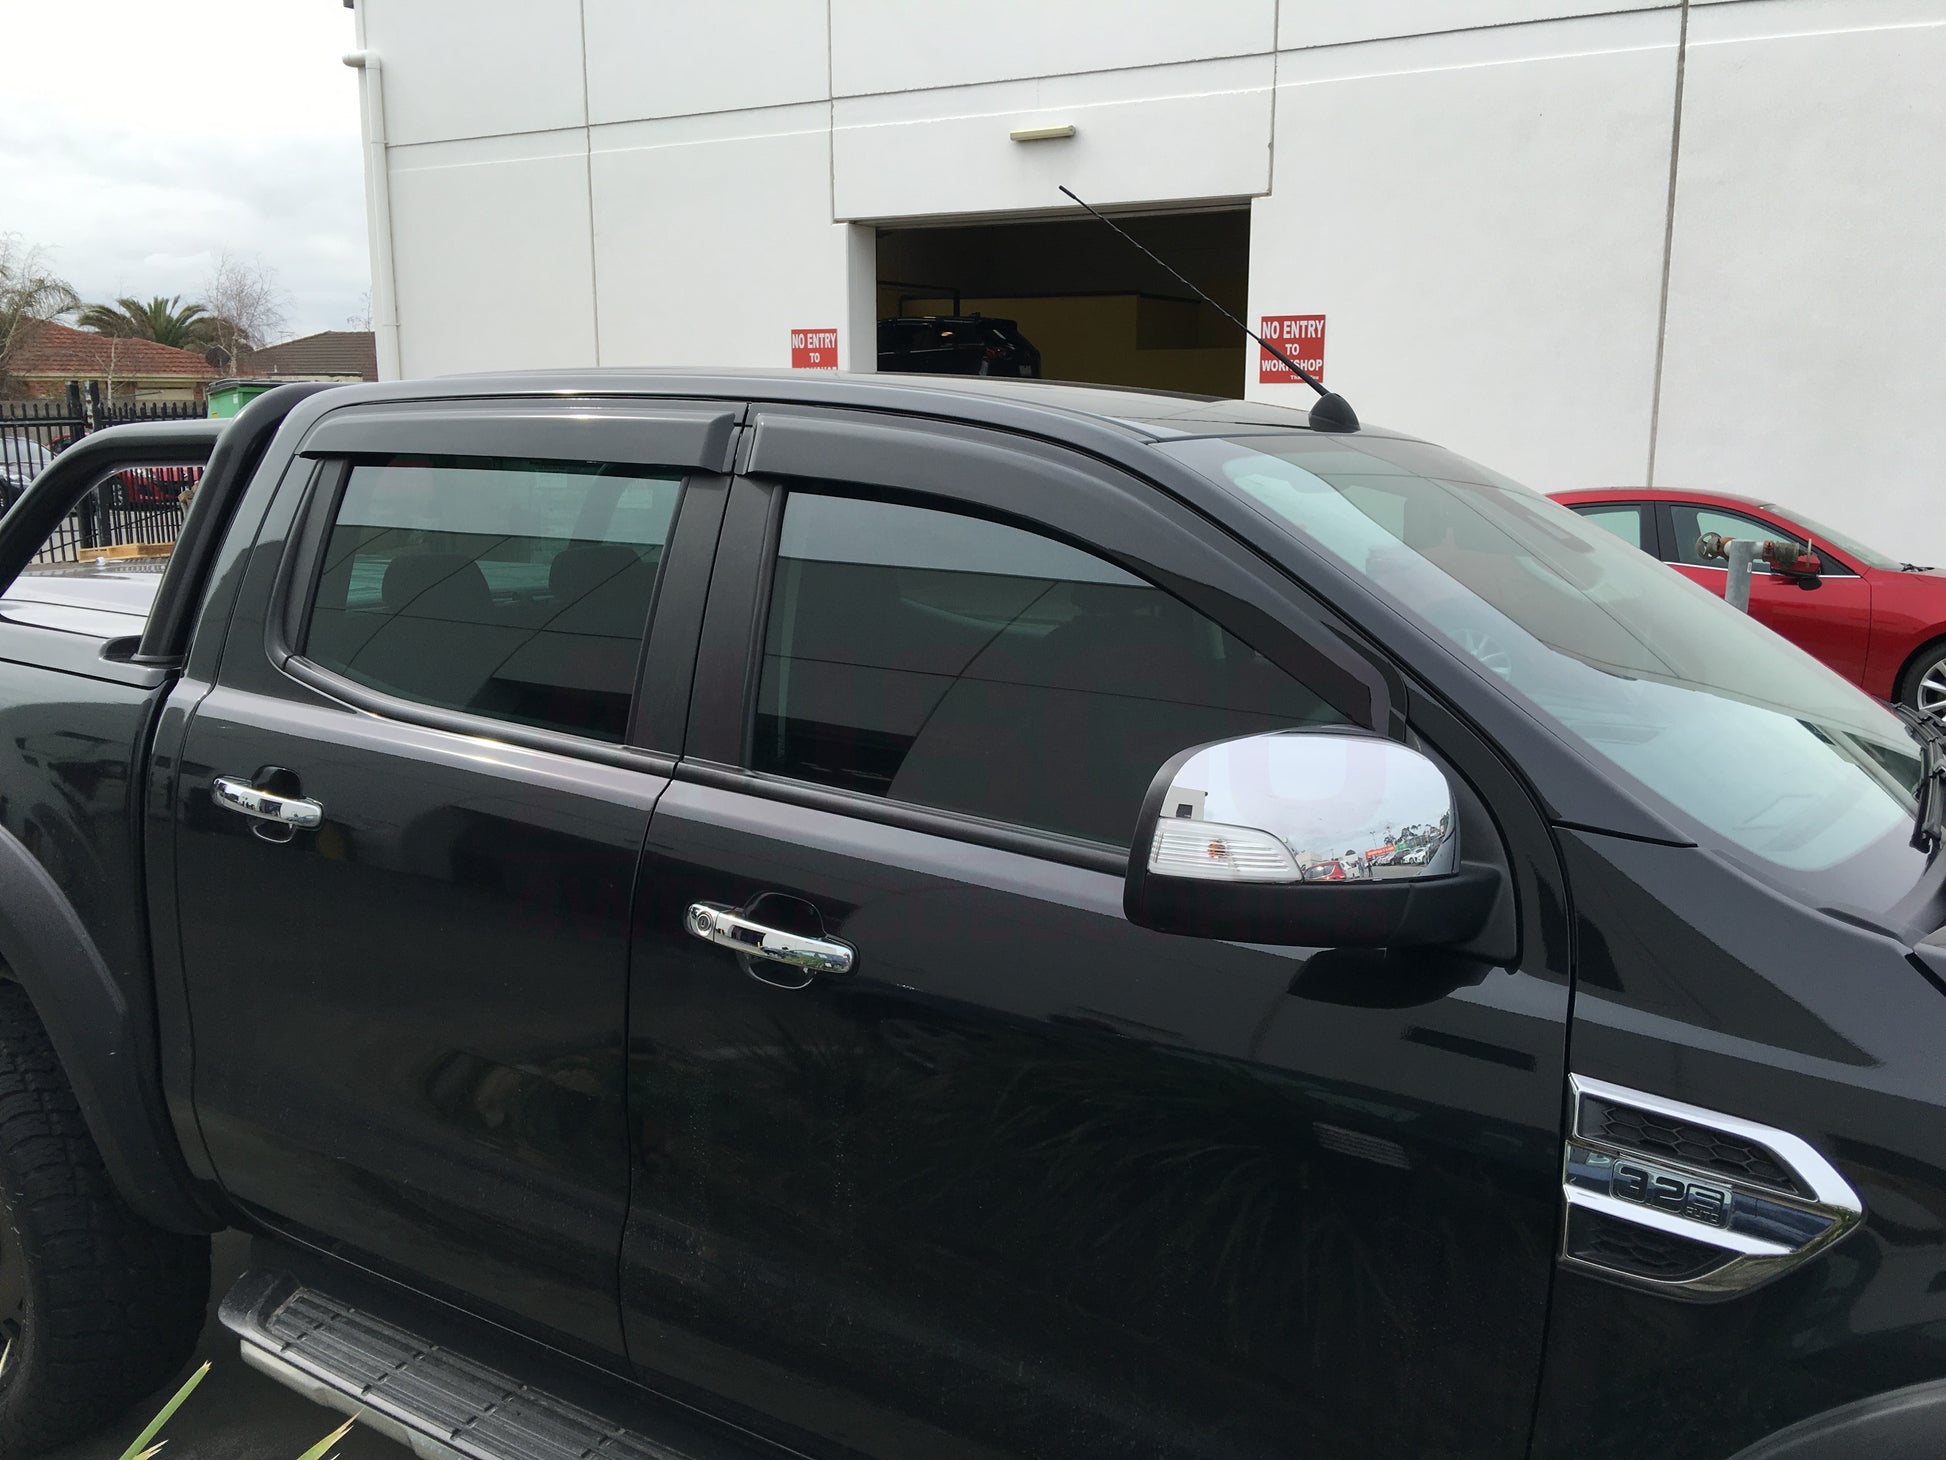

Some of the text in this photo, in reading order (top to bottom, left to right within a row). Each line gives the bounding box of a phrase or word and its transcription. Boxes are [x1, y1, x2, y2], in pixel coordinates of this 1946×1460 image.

[1262, 320, 1324, 339] NO ENTRY
[792, 332, 836, 349] NO ENTRY
[1285, 343, 1300, 356] TO
[809, 352, 821, 363] TO
